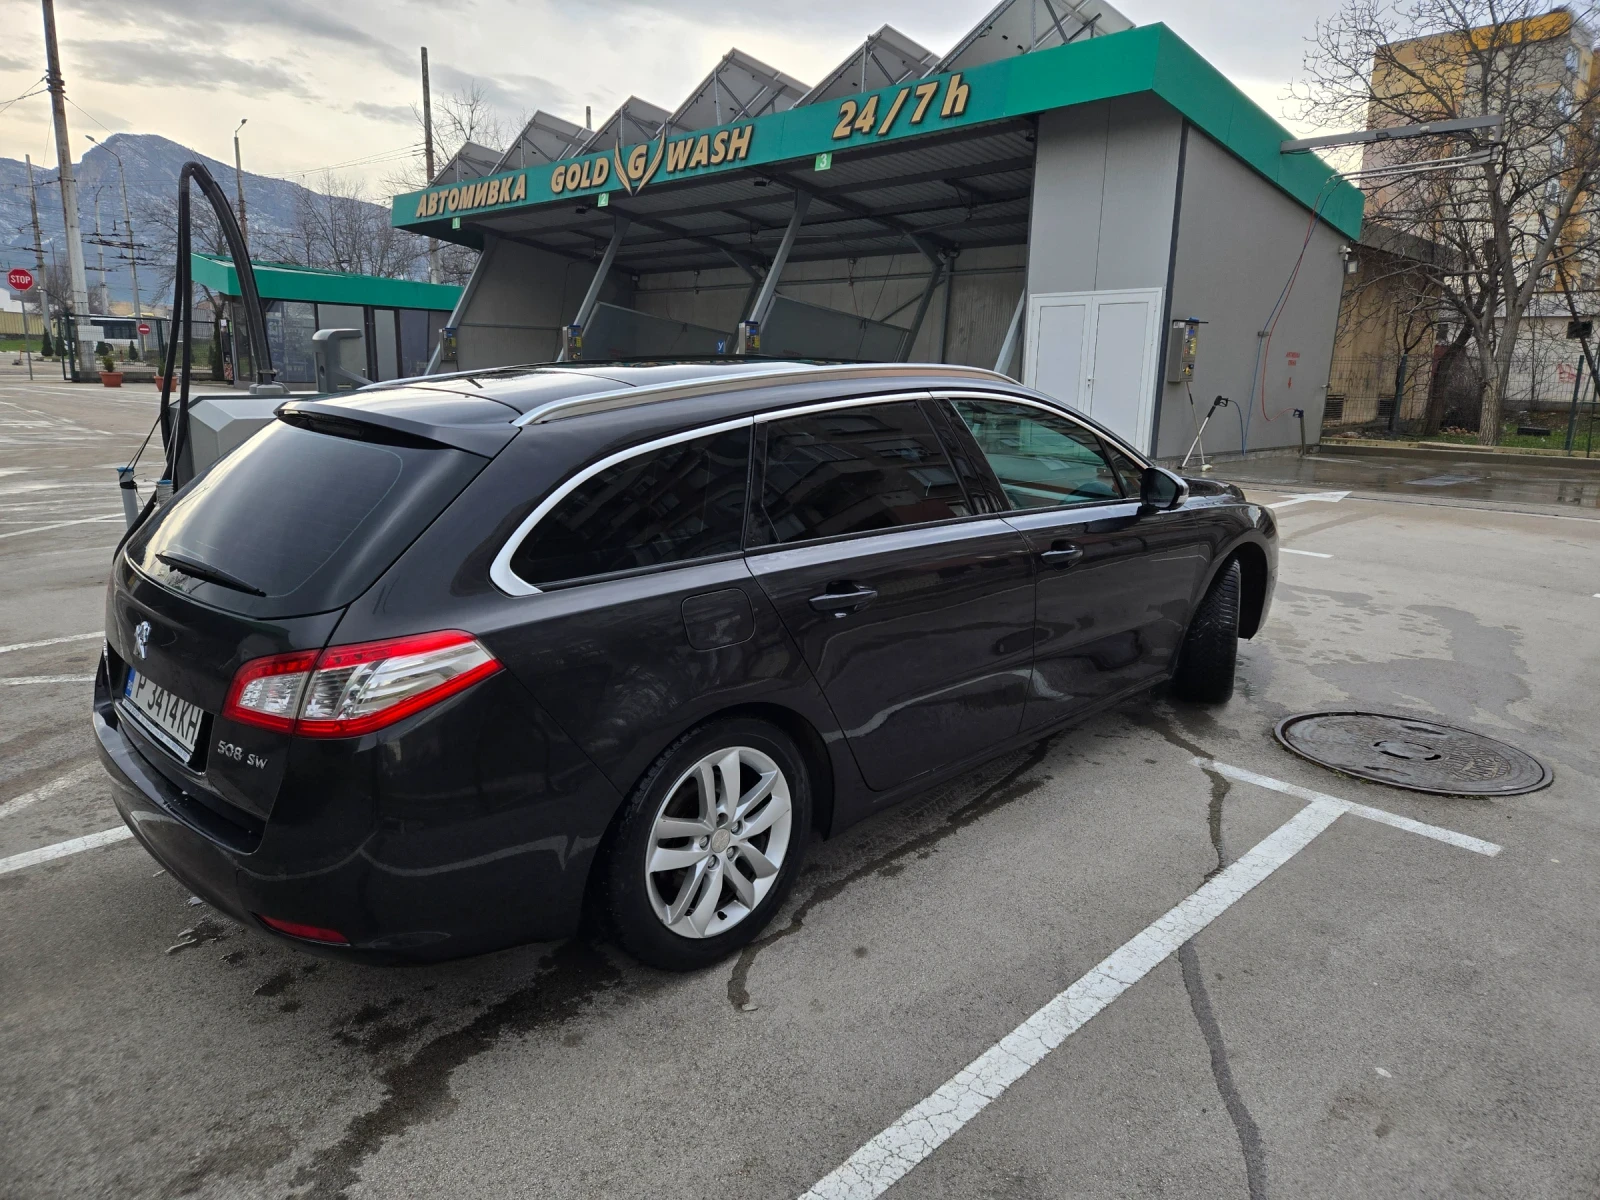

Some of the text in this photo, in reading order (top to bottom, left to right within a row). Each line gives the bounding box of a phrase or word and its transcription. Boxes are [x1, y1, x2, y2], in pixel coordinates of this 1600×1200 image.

[551, 125, 753, 194] GOLD G WASH
[819, 153, 828, 168] 3
[415, 174, 526, 218] АВТОМИВКА
[600, 195, 607, 205] 2
[10, 275, 31, 284] STOP
[217, 740, 268, 769] 508 SW
